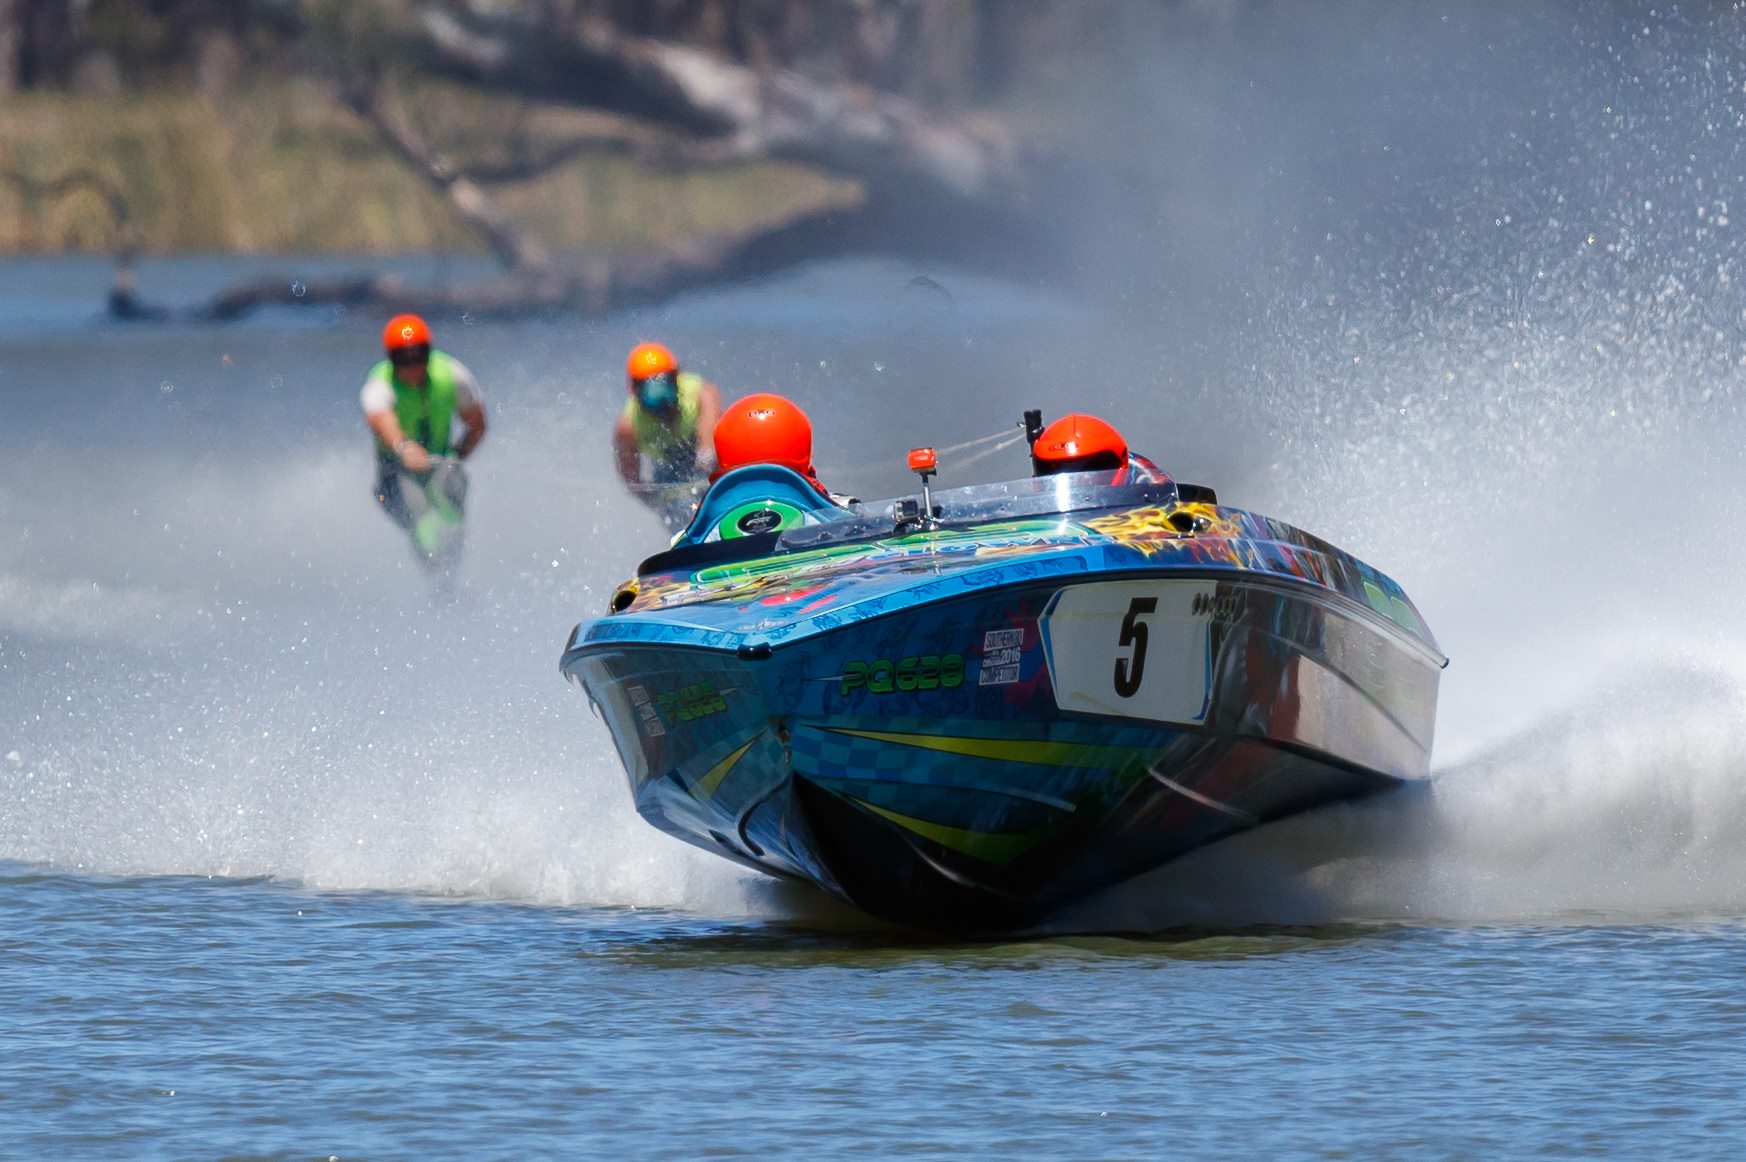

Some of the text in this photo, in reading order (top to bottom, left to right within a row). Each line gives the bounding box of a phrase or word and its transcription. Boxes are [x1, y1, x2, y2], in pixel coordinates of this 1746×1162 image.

[1001, 647, 1021, 663] 2016
[1114, 597, 1158, 698] 5
[840, 653, 965, 696] PQ628
